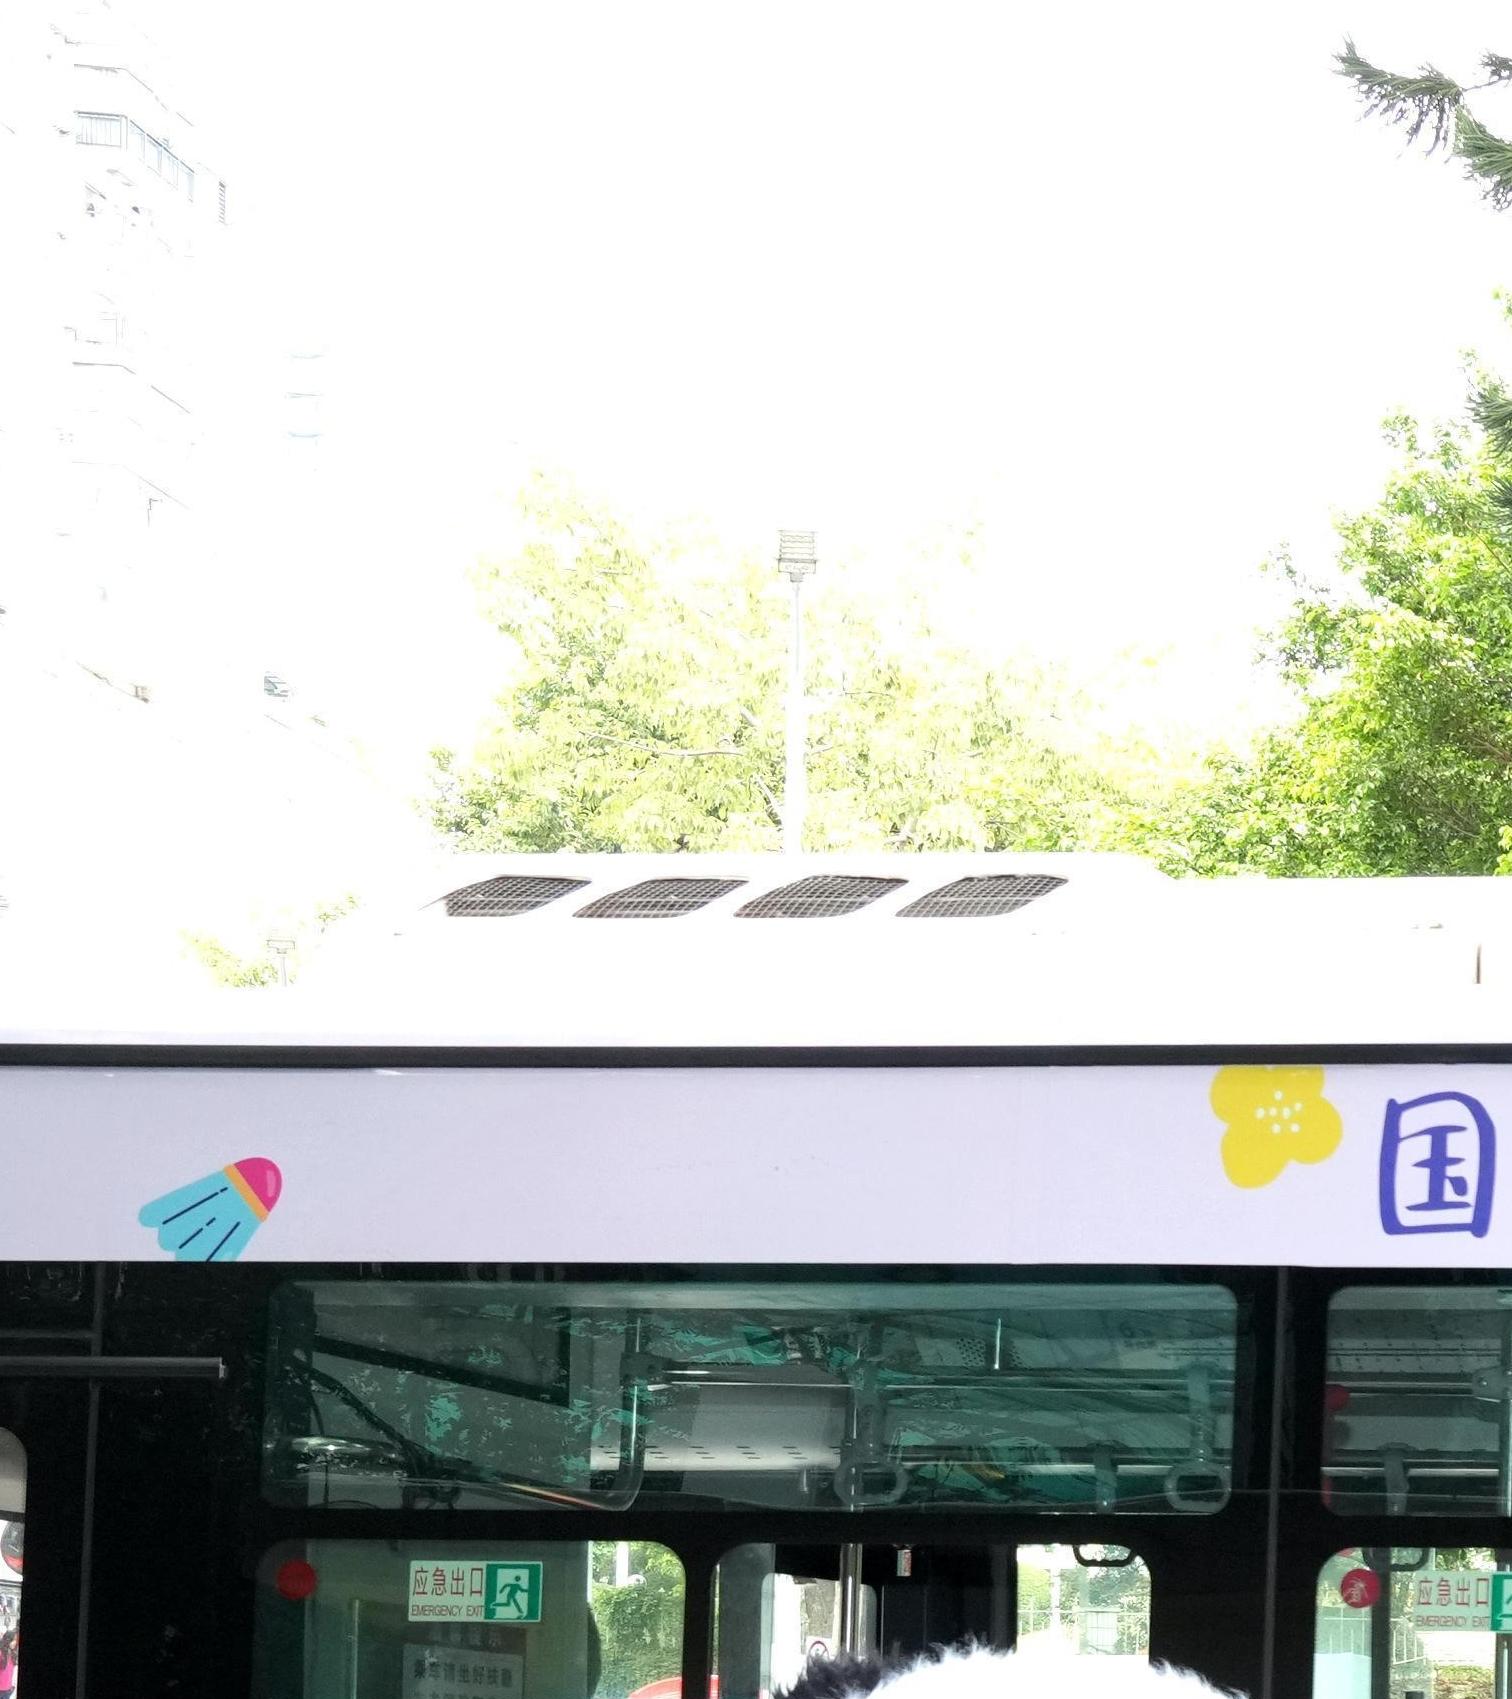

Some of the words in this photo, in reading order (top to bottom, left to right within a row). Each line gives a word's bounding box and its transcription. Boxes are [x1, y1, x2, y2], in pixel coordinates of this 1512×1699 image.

[413, 1567, 484, 1596] 应急出口
[1418, 1576, 1490, 1608] 应急出口
[411, 1604, 462, 1617] EMERGENCY
[466, 1604, 484, 1617] EXIT
[1416, 1615, 1467, 1627] EMERGENCY
